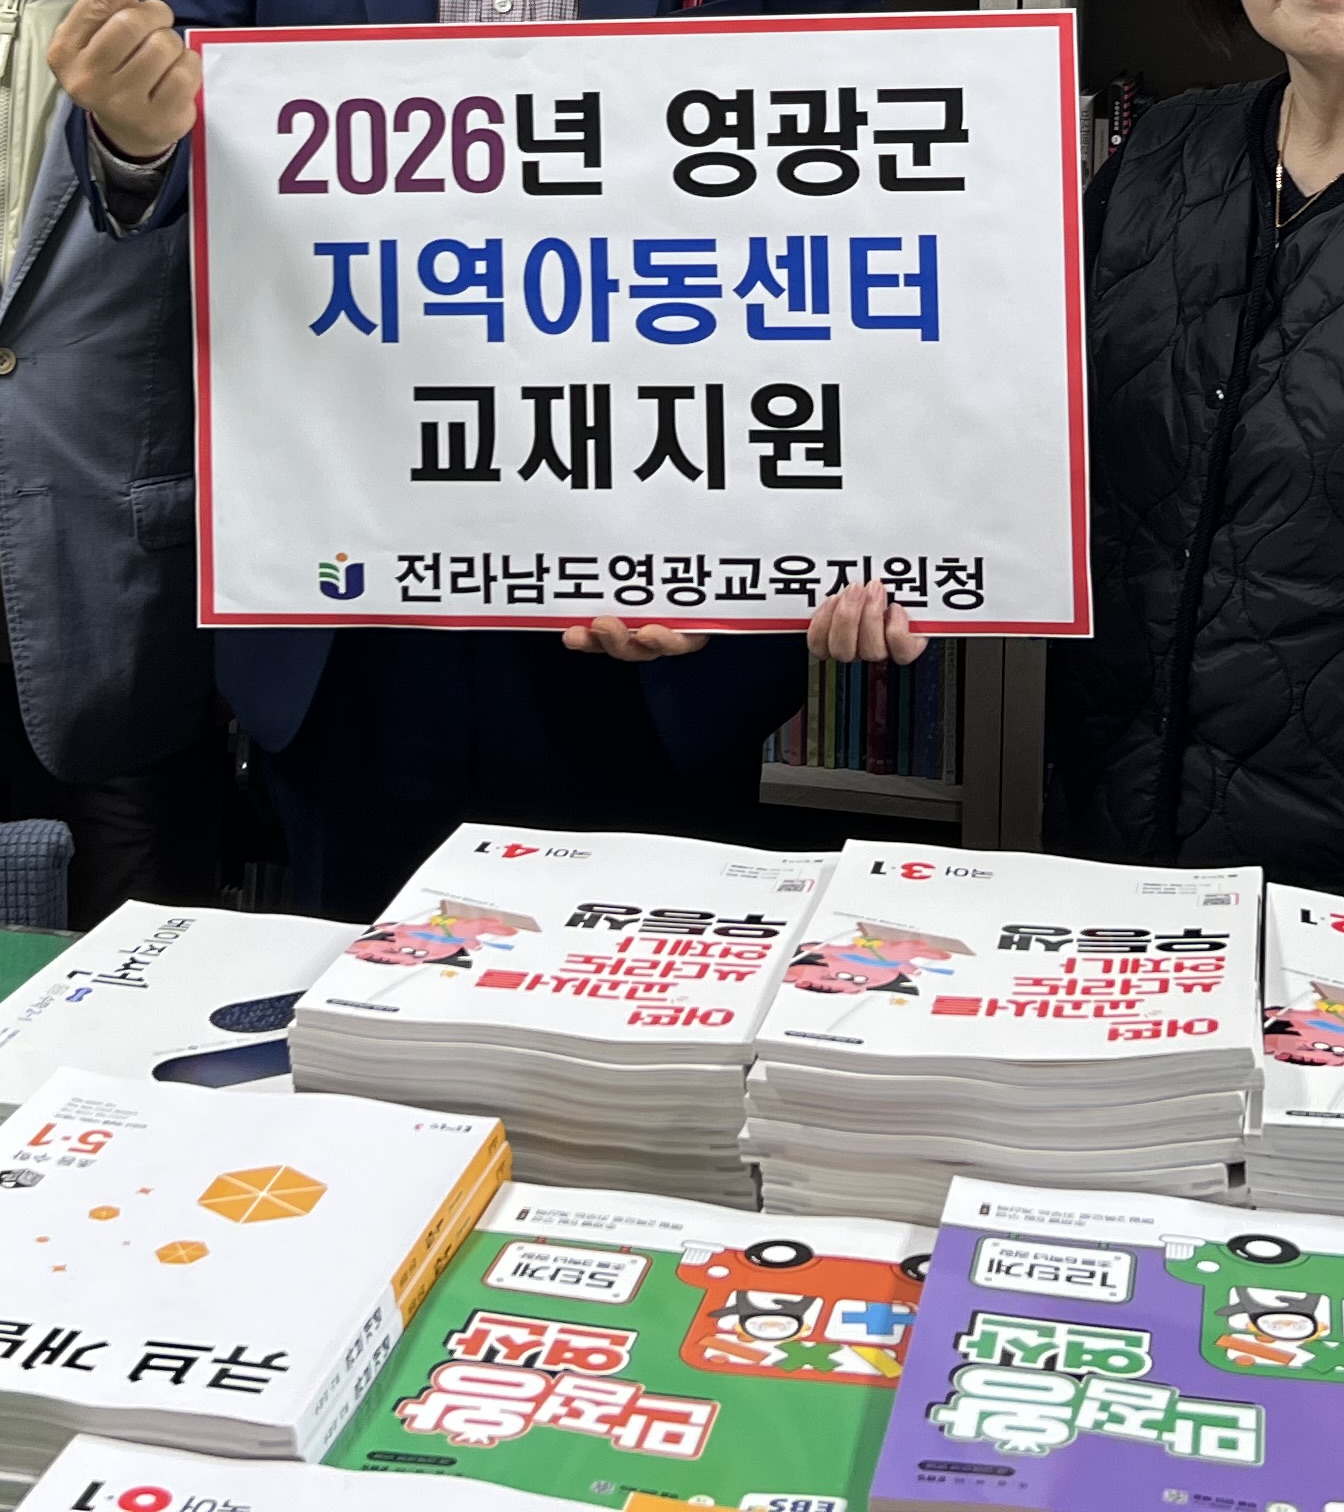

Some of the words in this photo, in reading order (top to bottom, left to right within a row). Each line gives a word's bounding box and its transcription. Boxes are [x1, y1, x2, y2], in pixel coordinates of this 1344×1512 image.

[277, 91, 602, 195] 2026년
[667, 87, 969, 197] 영광군
[310, 234, 940, 344] 지역아동센터
[409, 383, 844, 489] 교재지원
[395, 552, 986, 609] 전라남도영광교육지원청
[546, 846, 592, 860] 국어
[945, 865, 994, 880] 국어
[564, 903, 787, 939] 우등생
[616, 936, 773, 960] 언제나
[997, 925, 1230, 954] 우등생
[558, 954, 762, 984] 쓰더라도
[1059, 956, 1226, 974] 언제나
[473, 969, 679, 1002] 교과서를
[1012, 976, 1225, 996] 쓰더라도
[626, 1005, 735, 1027] 어떤
[930, 996, 1144, 1018] 교과서를
[1107, 1018, 1220, 1041] 어떤
[511, 1262, 619, 1289] 5단계
[987, 1258, 1116, 1288] 12단계
[448, 1311, 638, 1374] 연산
[957, 1312, 1152, 1377] 연산
[126, 1340, 291, 1394] 큐브
[397, 1361, 719, 1460] 만점왕
[928, 1364, 1265, 1467] 만점왕
